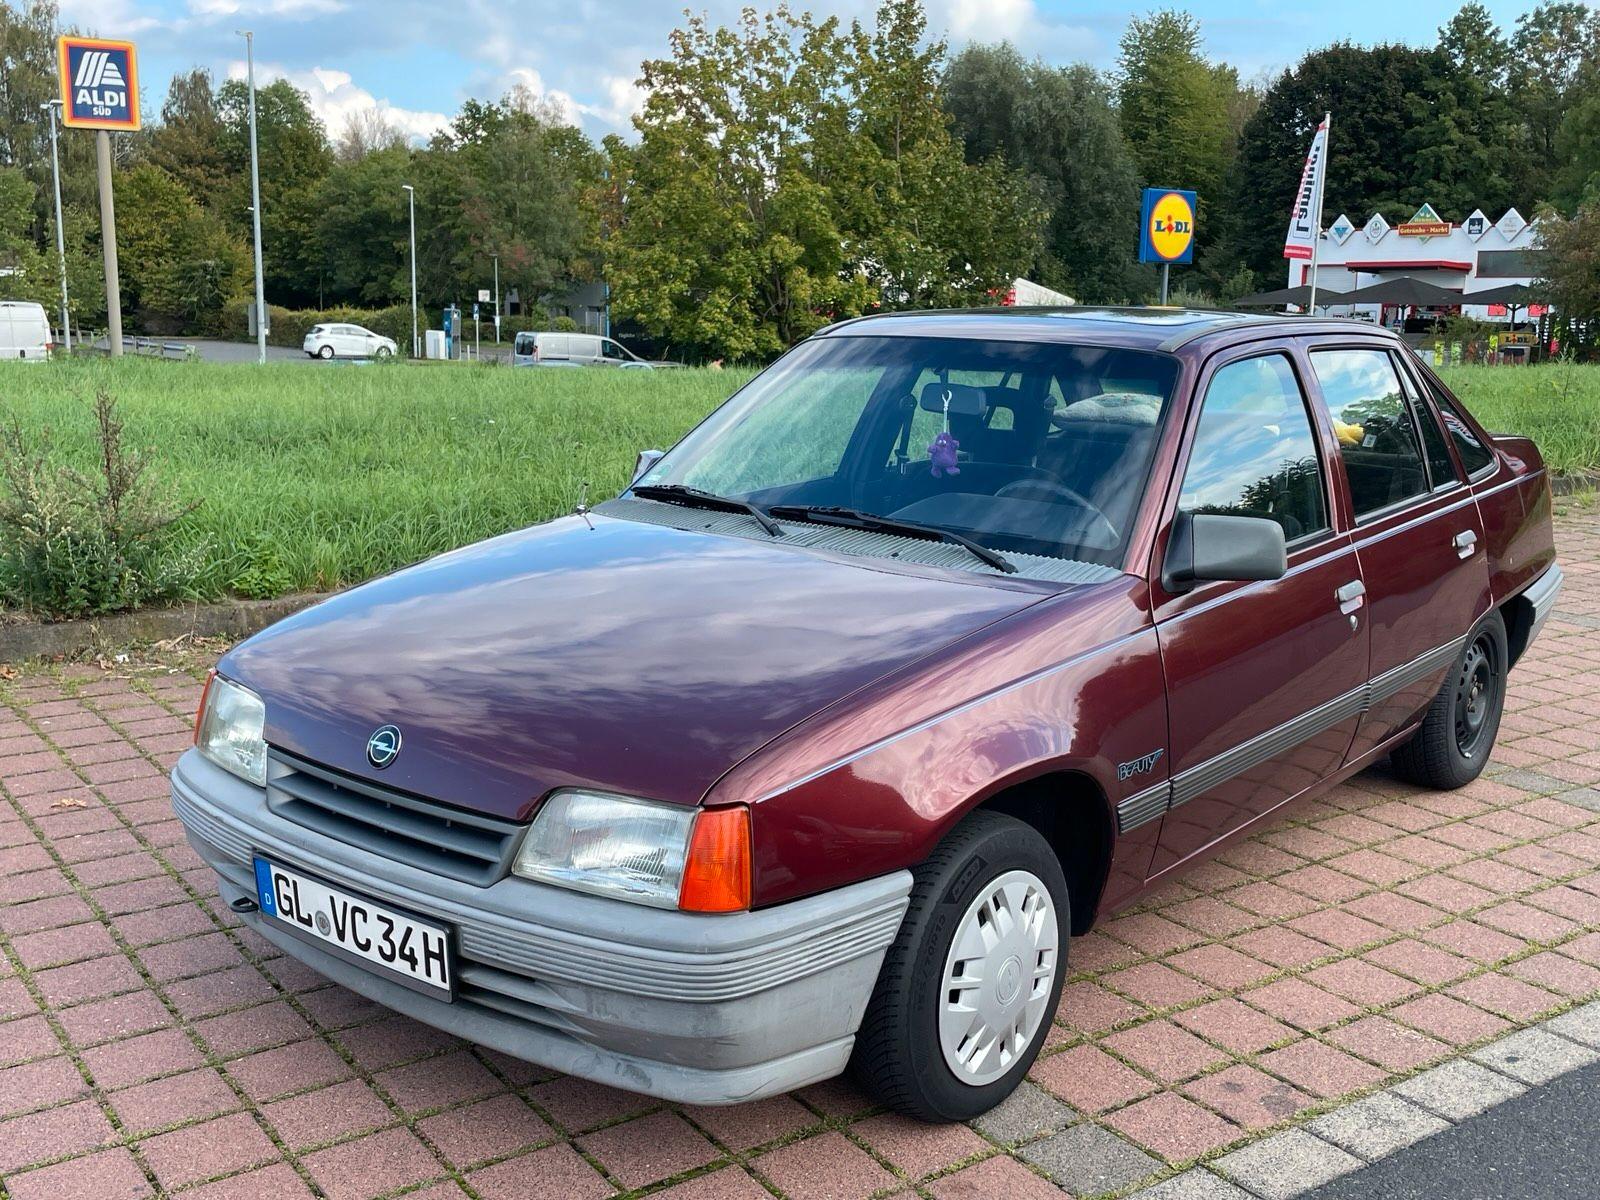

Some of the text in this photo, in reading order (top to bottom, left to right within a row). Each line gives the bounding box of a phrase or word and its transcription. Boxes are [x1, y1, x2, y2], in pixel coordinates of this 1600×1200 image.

[76, 89, 126, 107] ALDI
[93, 105, 112, 115] SÜD
[265, 893, 271, 905] D
[274, 873, 313, 928] GL
